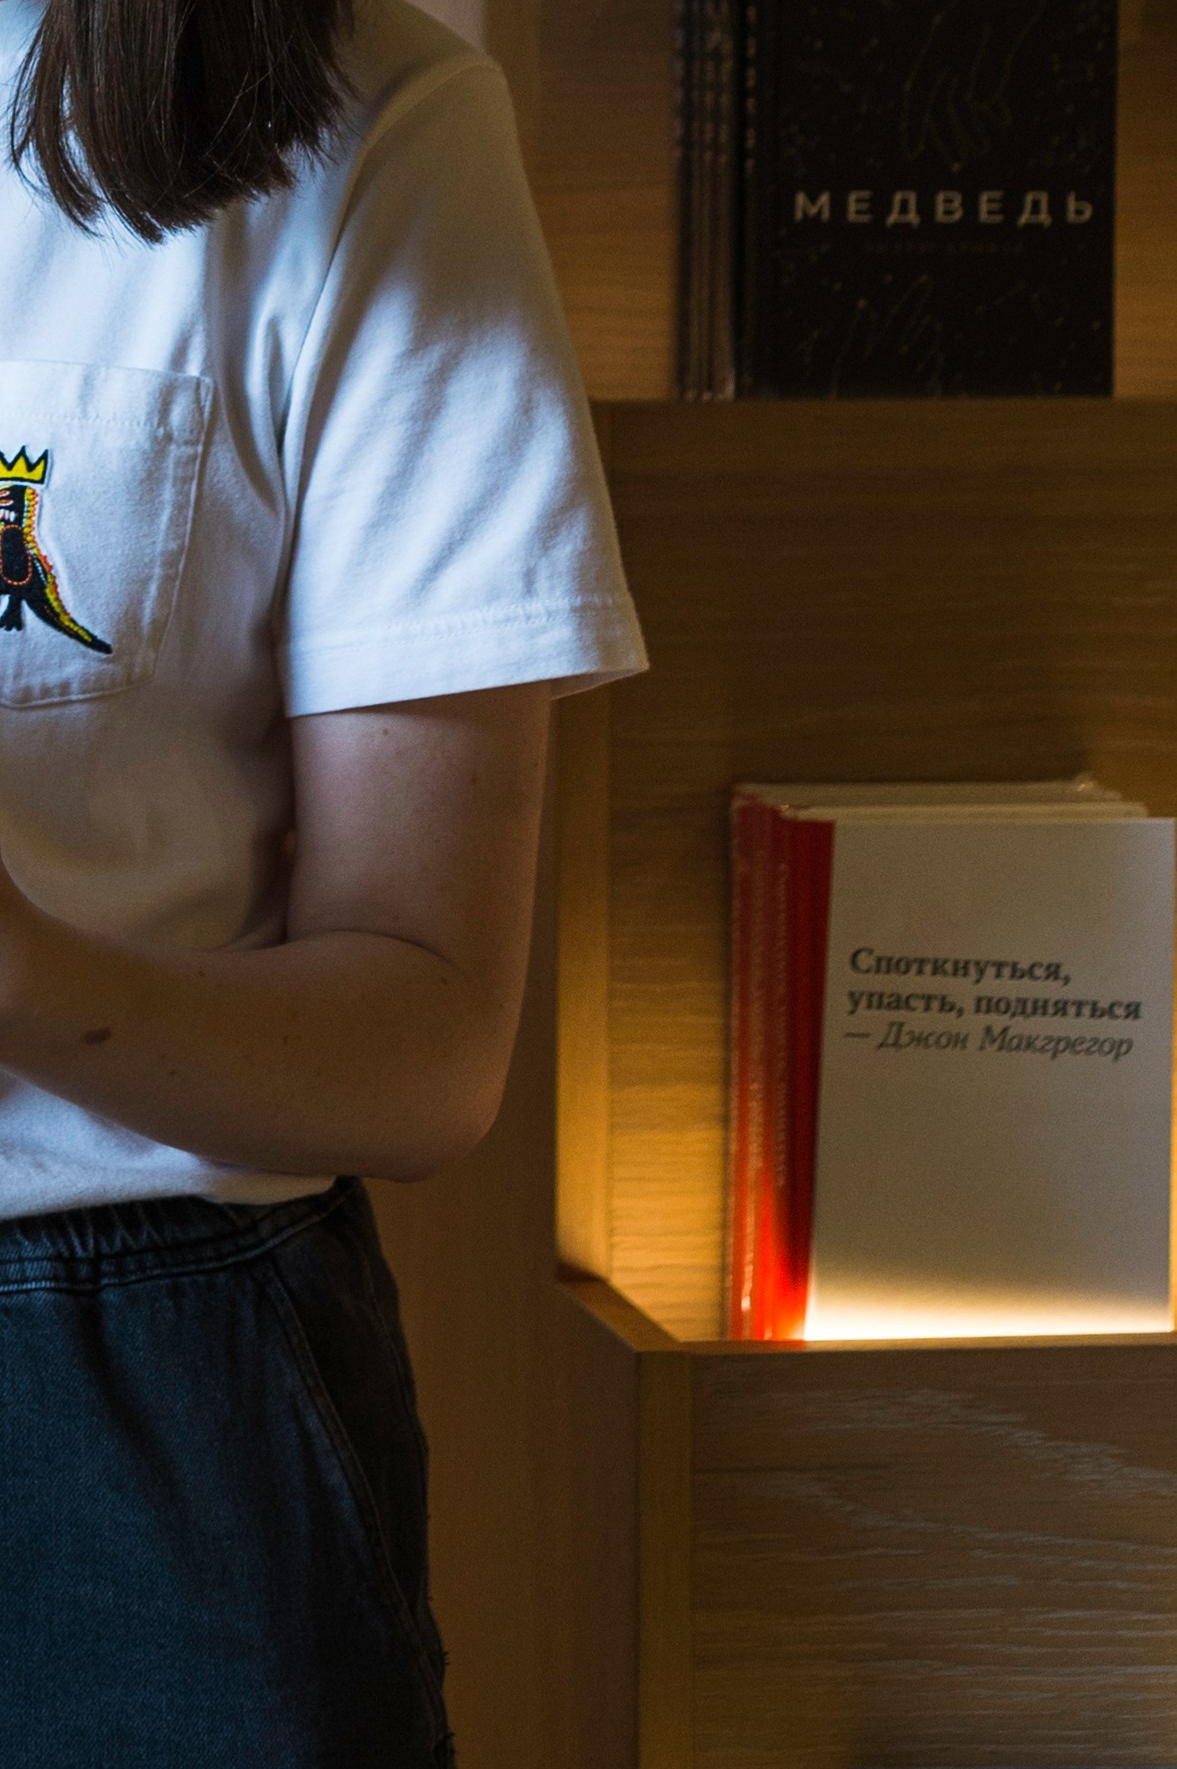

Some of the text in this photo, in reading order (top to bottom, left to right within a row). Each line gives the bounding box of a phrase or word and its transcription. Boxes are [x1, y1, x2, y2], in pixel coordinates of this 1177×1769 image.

[793, 189, 1094, 230] МЕДВЕДЬ
[849, 946, 1072, 987] Споткнуться,
[847, 988, 1143, 1021] упасть, подняться
[876, 1019, 970, 1051] Джон
[978, 1024, 1135, 1062] Макгрегор
